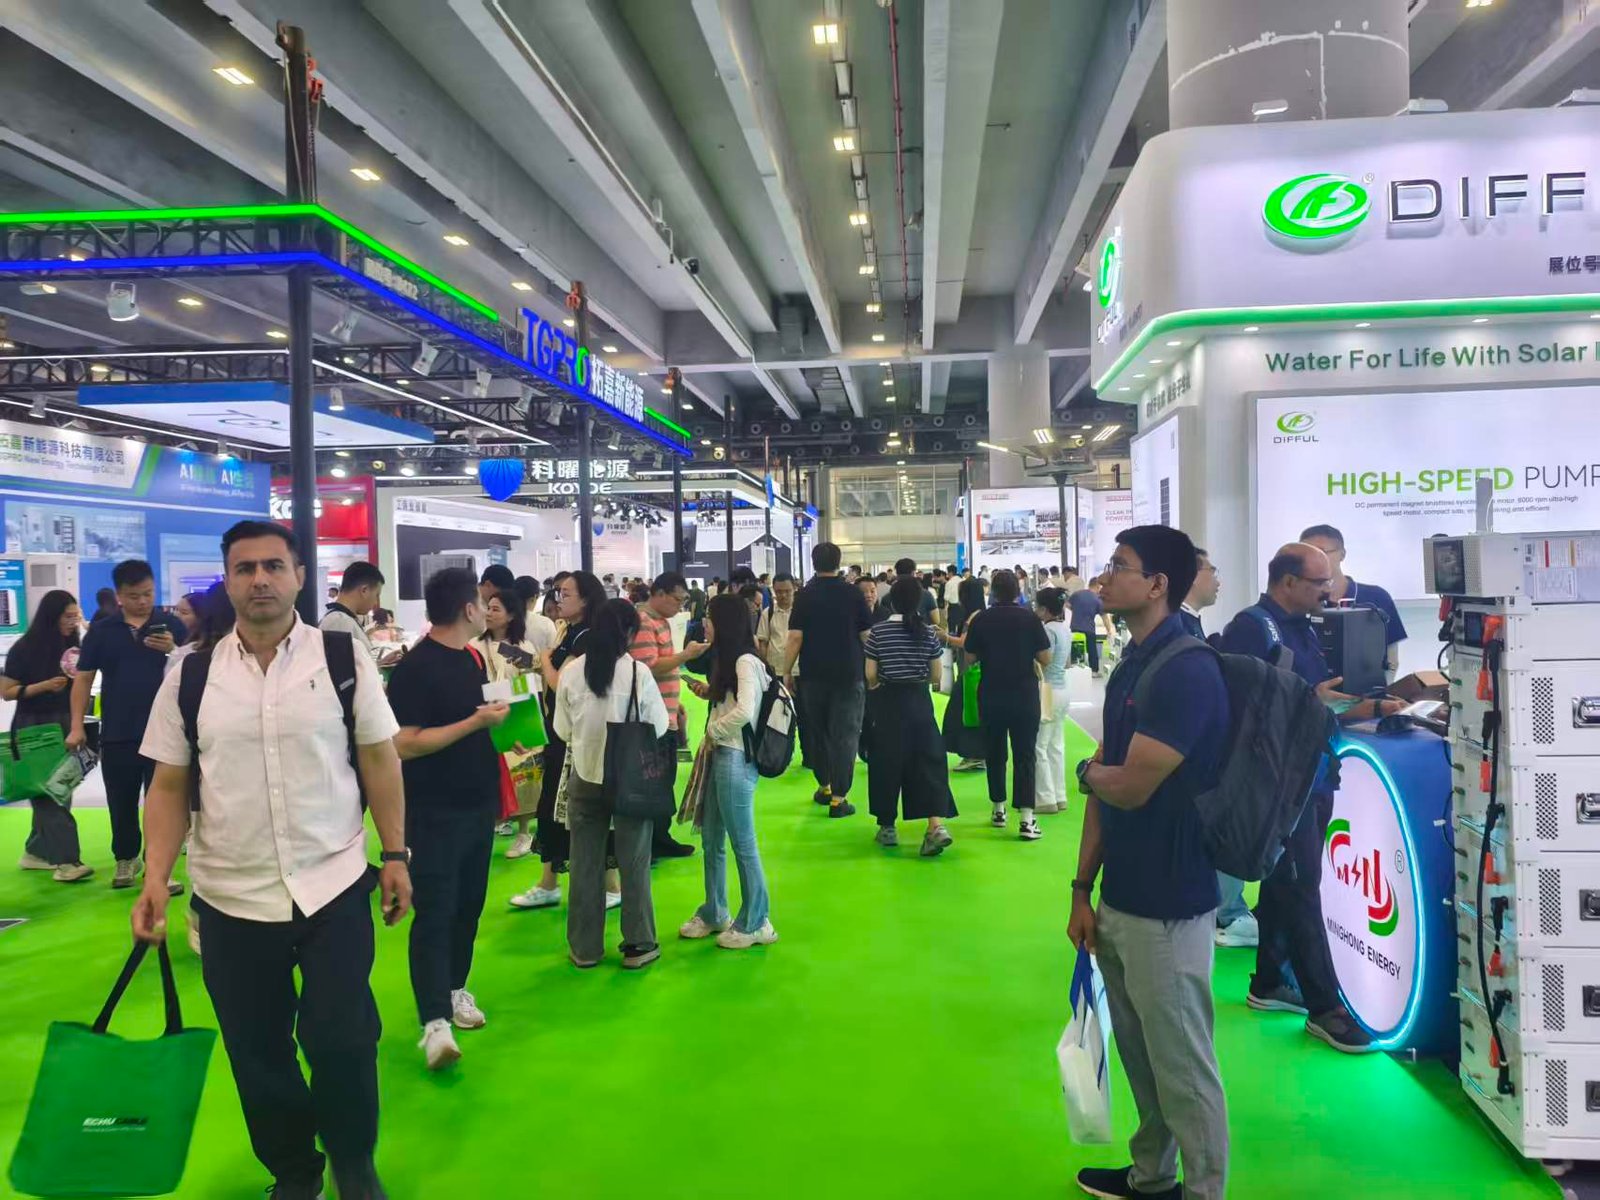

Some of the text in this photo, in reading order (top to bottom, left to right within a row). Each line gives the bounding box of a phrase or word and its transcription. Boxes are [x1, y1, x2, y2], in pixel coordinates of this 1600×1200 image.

[520, 307, 591, 394] TGPRO
[1265, 353, 1342, 372] Water
[1349, 350, 1392, 369] For
[1399, 347, 1446, 367] Life
[1452, 346, 1510, 366] With
[1518, 342, 1588, 363] Solar
[1273, 435, 1320, 444] DIFFUL
[1326, 916, 1401, 980] MINGHONG ENERGY
